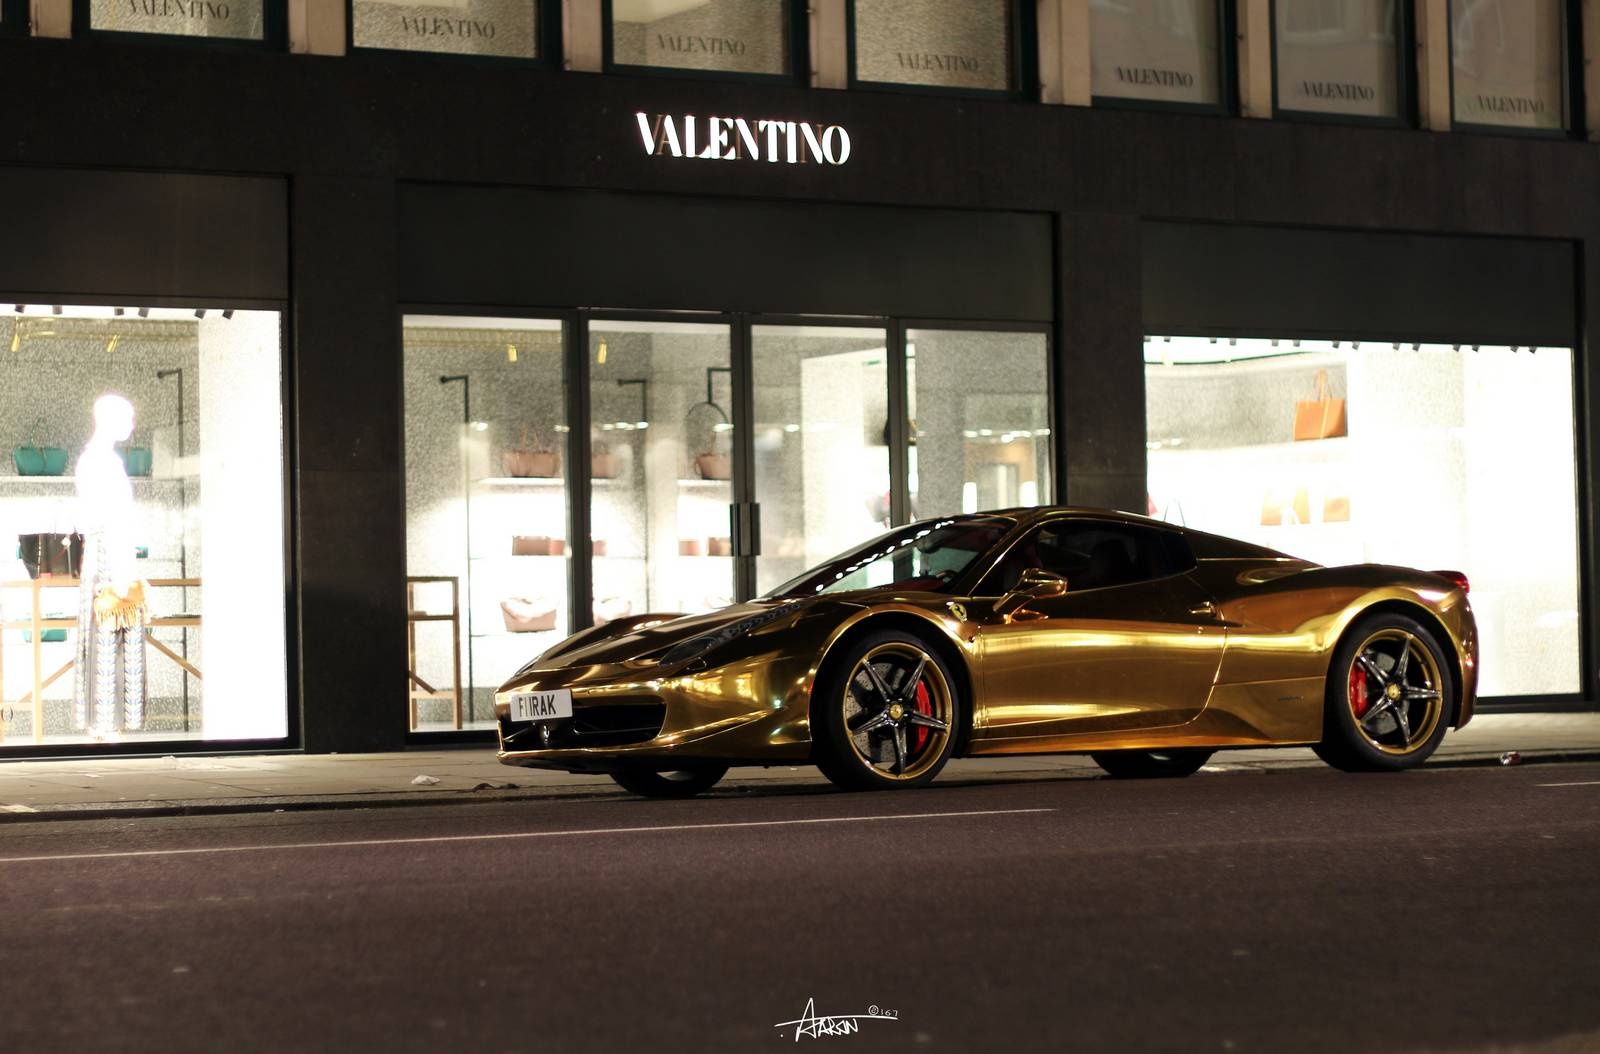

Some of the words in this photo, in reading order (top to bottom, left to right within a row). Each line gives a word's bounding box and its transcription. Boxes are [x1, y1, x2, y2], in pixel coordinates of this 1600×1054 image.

[128, 0, 230, 20] VALENTINO
[401, 15, 496, 39] VALENTINO
[657, 33, 746, 56] VALENTINO
[897, 52, 979, 72] VALENTINO
[1116, 66, 1194, 88] VALENTINO
[1301, 80, 1376, 101] VALENTINO
[1477, 94, 1545, 114] VALENTINO
[635, 112, 851, 165] VALENTINO
